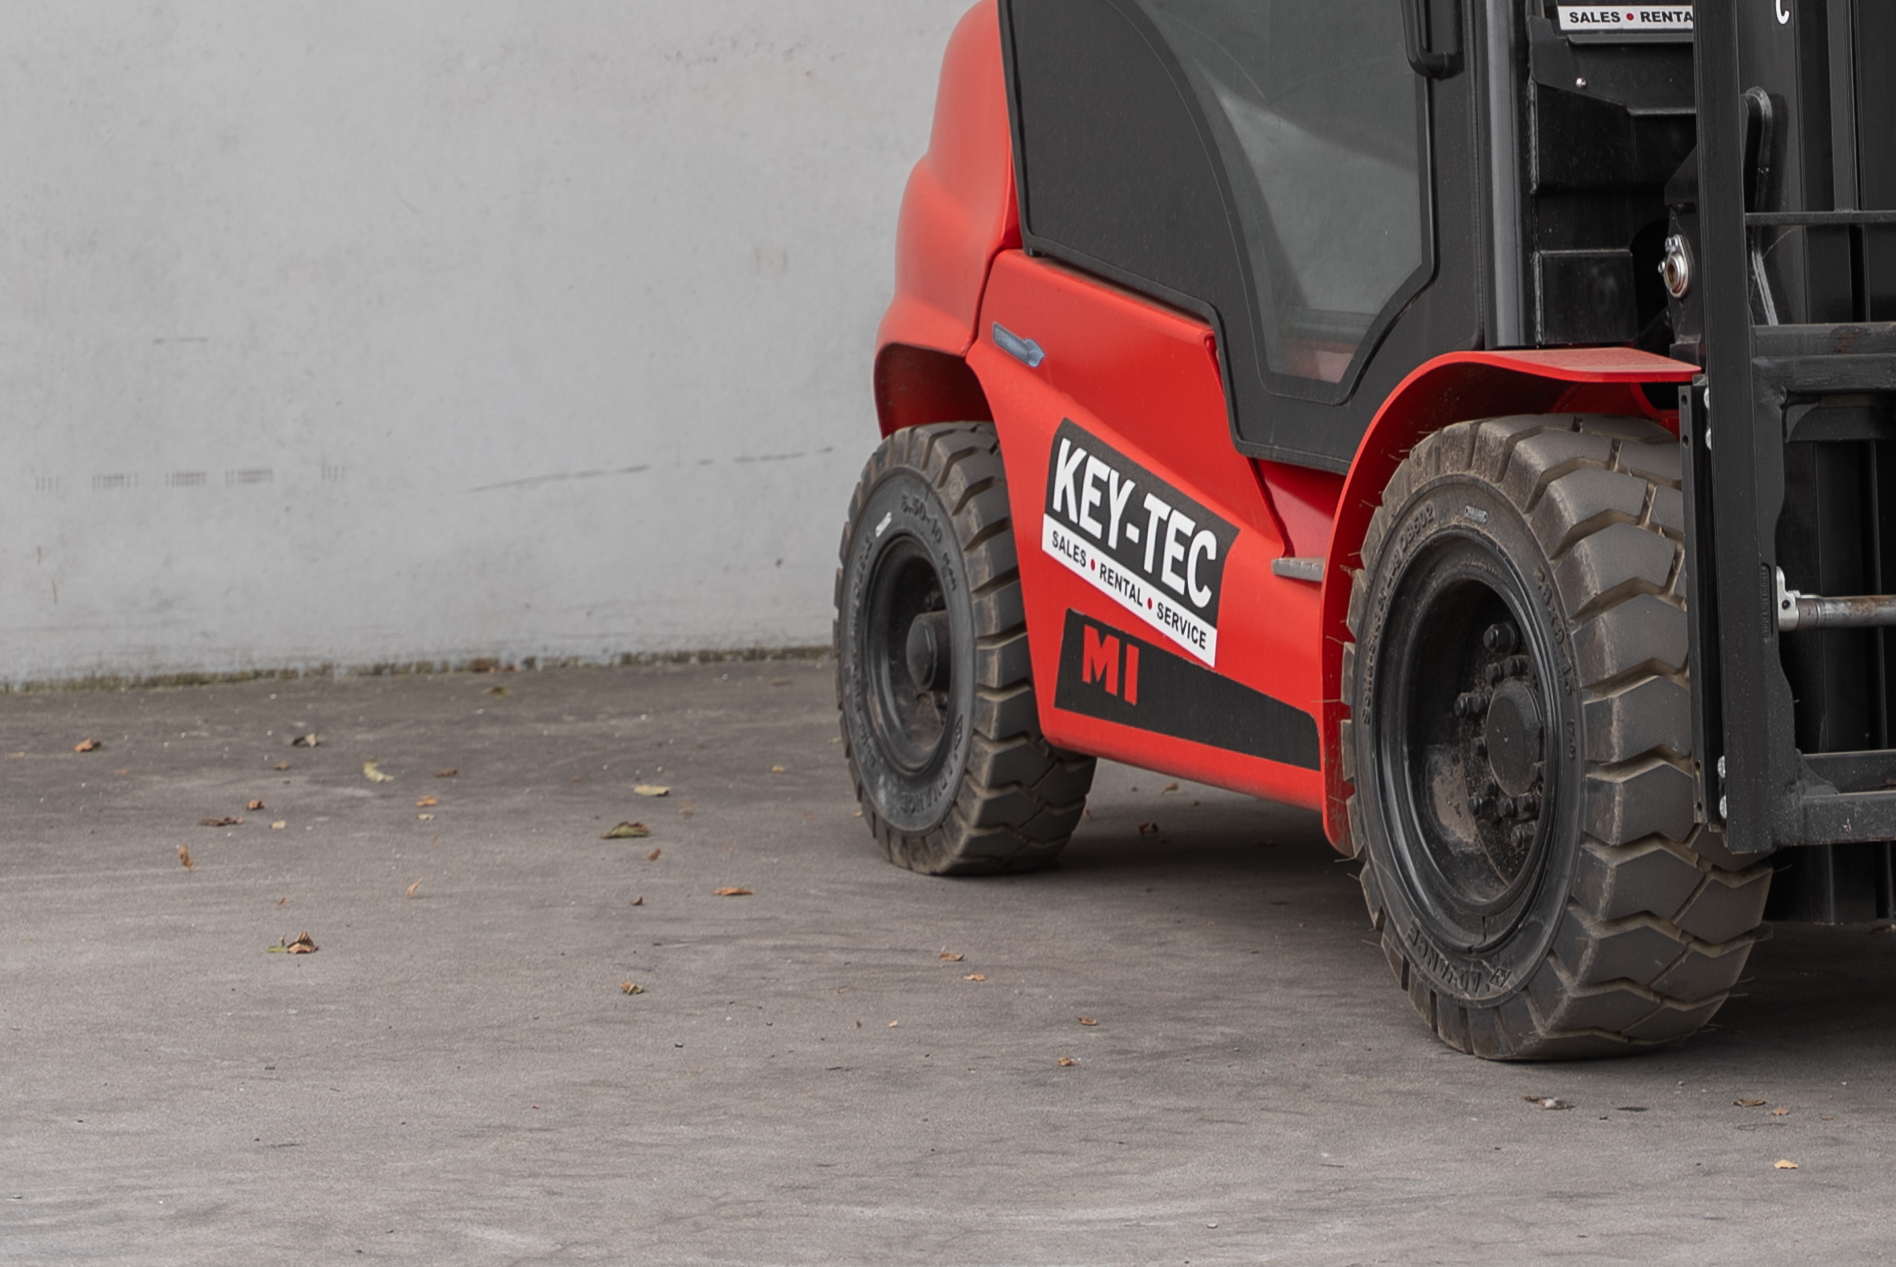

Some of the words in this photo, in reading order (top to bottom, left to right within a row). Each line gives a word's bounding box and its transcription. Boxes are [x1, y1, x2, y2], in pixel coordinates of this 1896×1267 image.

[1569, 11, 1622, 24] SALES
[1640, 11, 1693, 23] RENTA
[1052, 437, 1218, 609] KEY-TEC
[1051, 531, 1087, 568] SALES
[1099, 562, 1144, 608] RENTAL
[1156, 601, 1207, 651] SERVICE
[1082, 624, 1140, 706] MI
